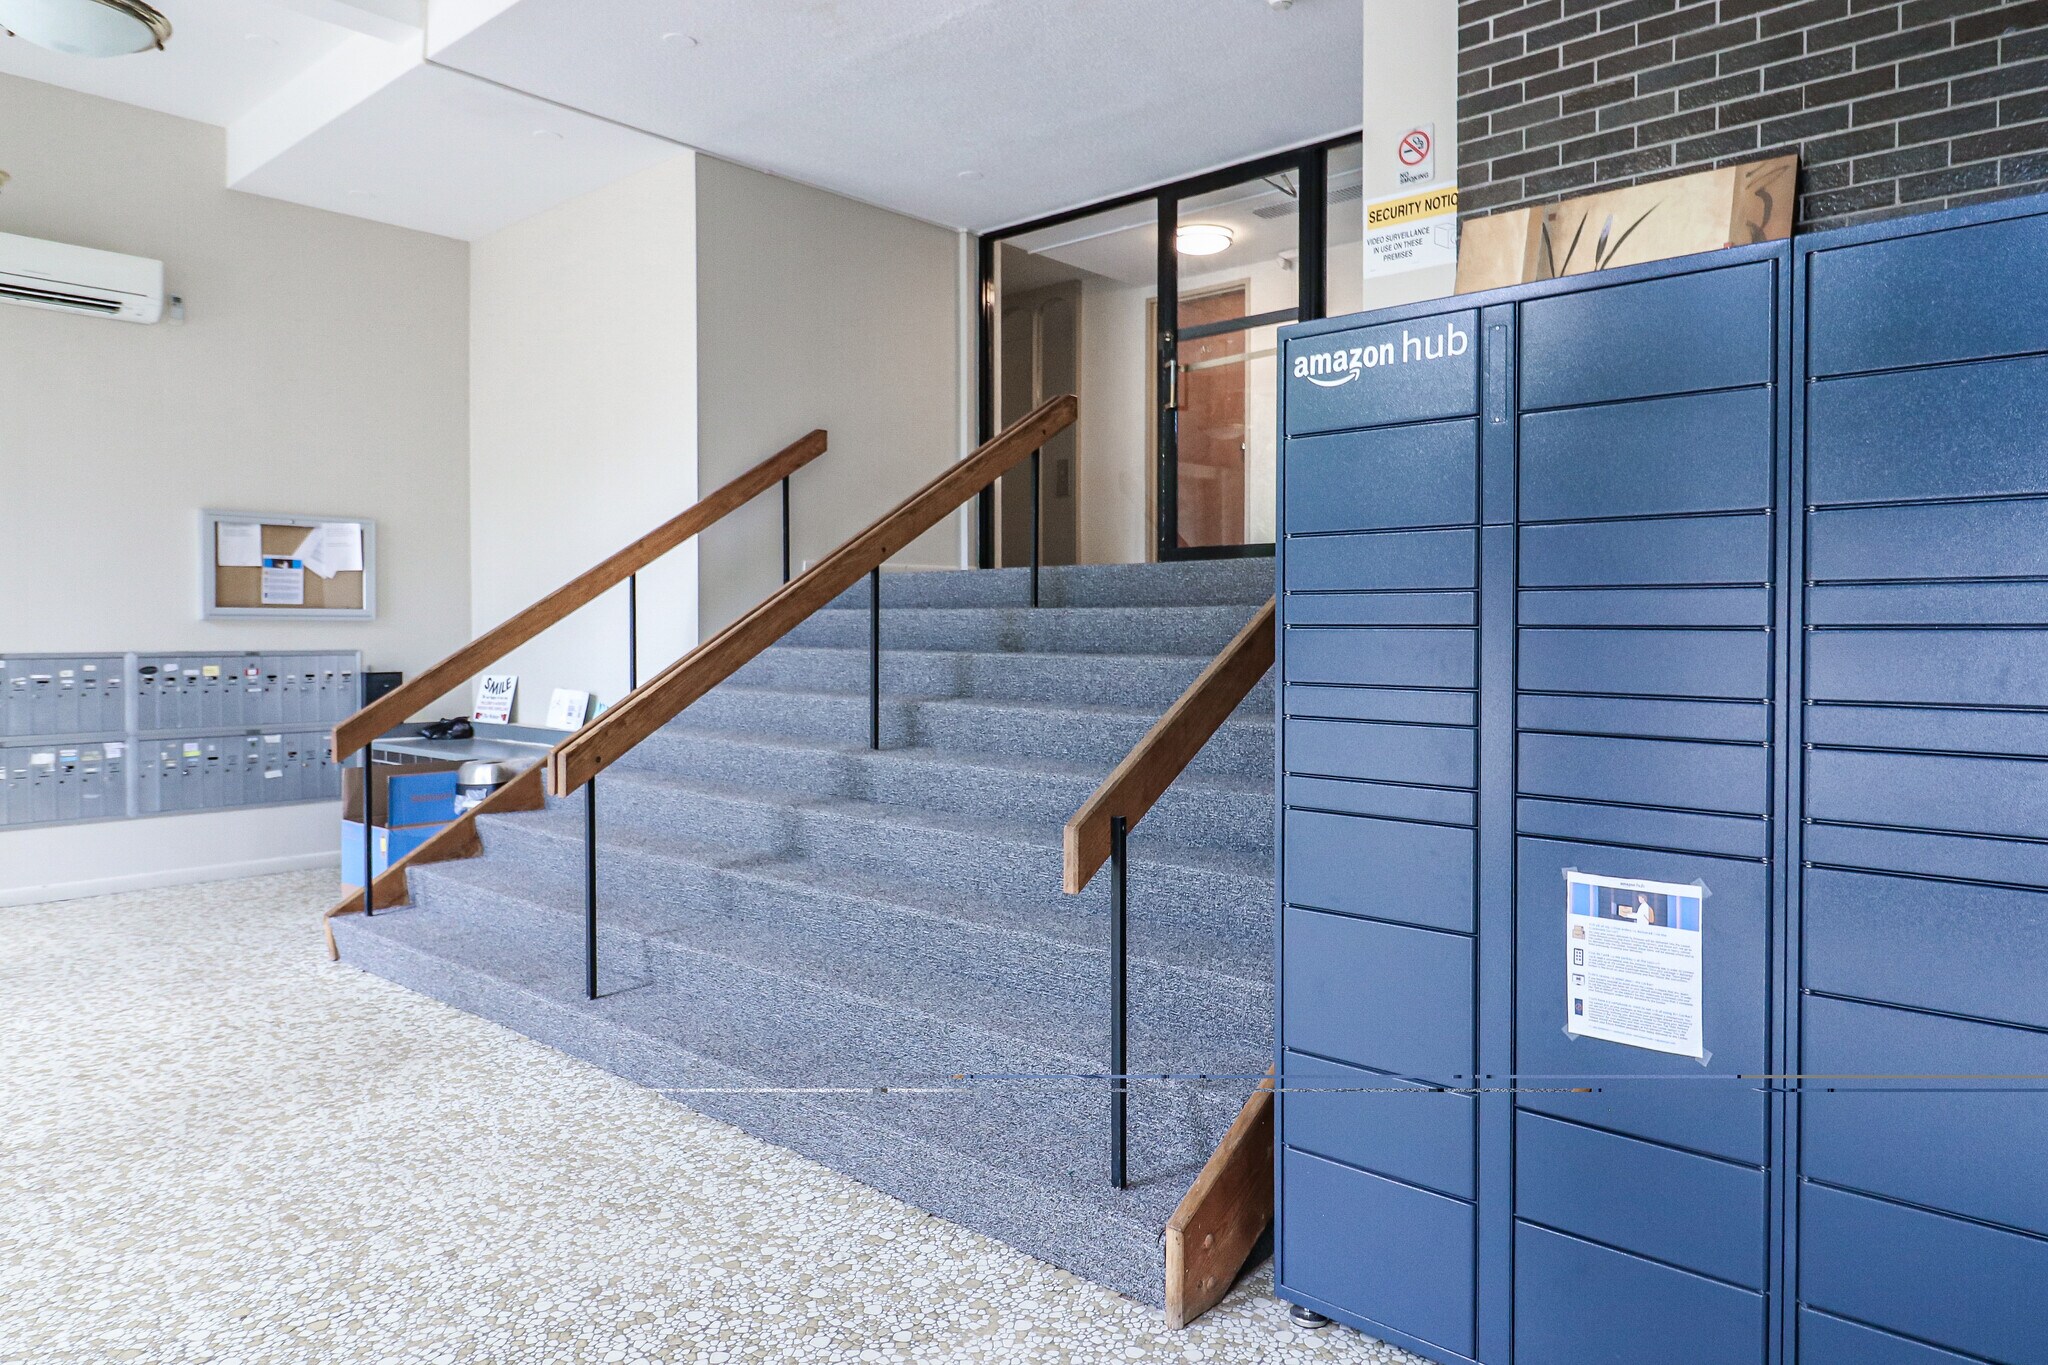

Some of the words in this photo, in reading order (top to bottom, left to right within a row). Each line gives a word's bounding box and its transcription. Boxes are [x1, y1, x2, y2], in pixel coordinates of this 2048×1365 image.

[1399, 172, 1409, 181] NO
[1400, 172, 1429, 184] SMOKING
[1369, 201, 1421, 224] SECURITY
[1367, 236, 1385, 246] VIDEO
[1386, 227, 1430, 242] SURVEILLANCE
[1381, 244, 1392, 253] USE
[1394, 242, 1403, 250] ON
[1404, 238, 1423, 248] THESE
[1383, 250, 1413, 262] PREMISES
[1294, 342, 1394, 379] amazon
[1402, 323, 1468, 363] hub
[484, 677, 512, 695] SMILE
